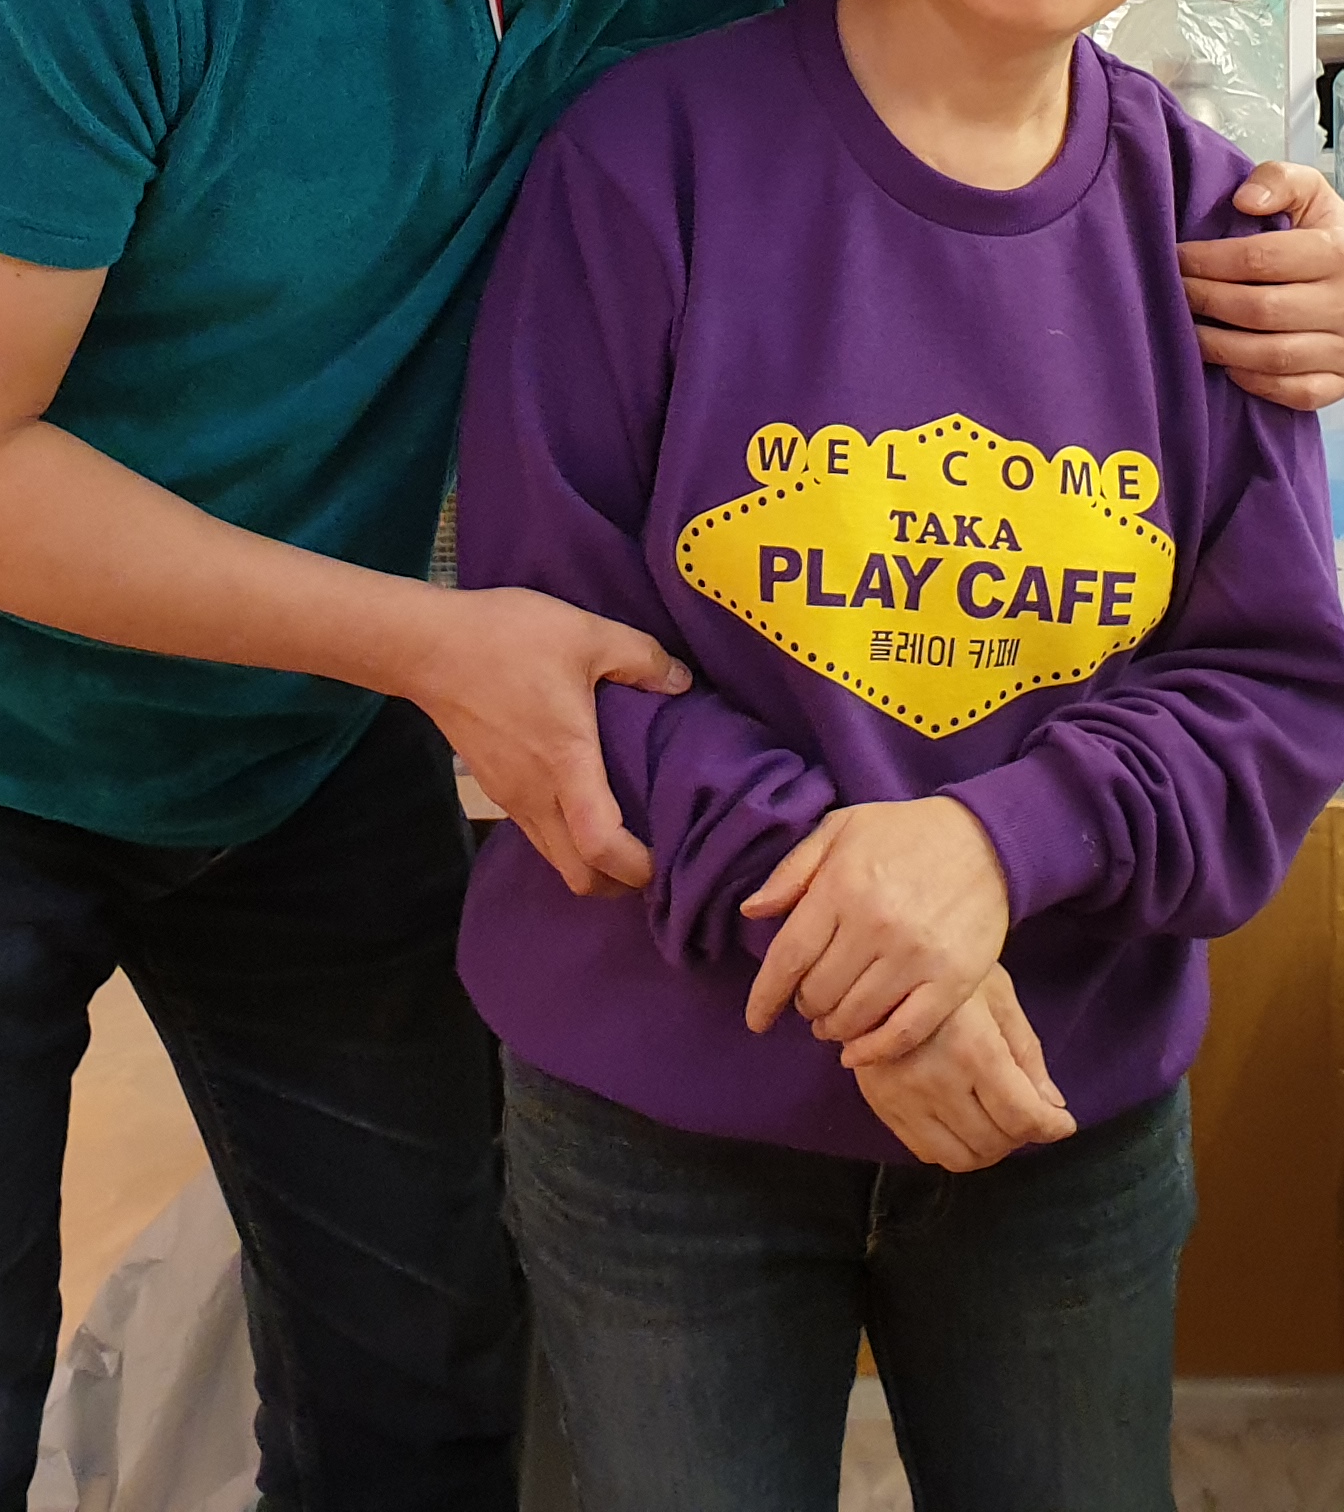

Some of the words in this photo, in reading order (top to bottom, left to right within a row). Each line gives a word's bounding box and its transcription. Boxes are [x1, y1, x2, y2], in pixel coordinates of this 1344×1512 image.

[757, 436, 1141, 501] WELCOME
[889, 509, 1023, 553] TAKA
[758, 544, 945, 613] PLAY
[955, 560, 1138, 628] CAFE
[869, 629, 956, 669] 플레이
[967, 638, 1023, 670] 카페
